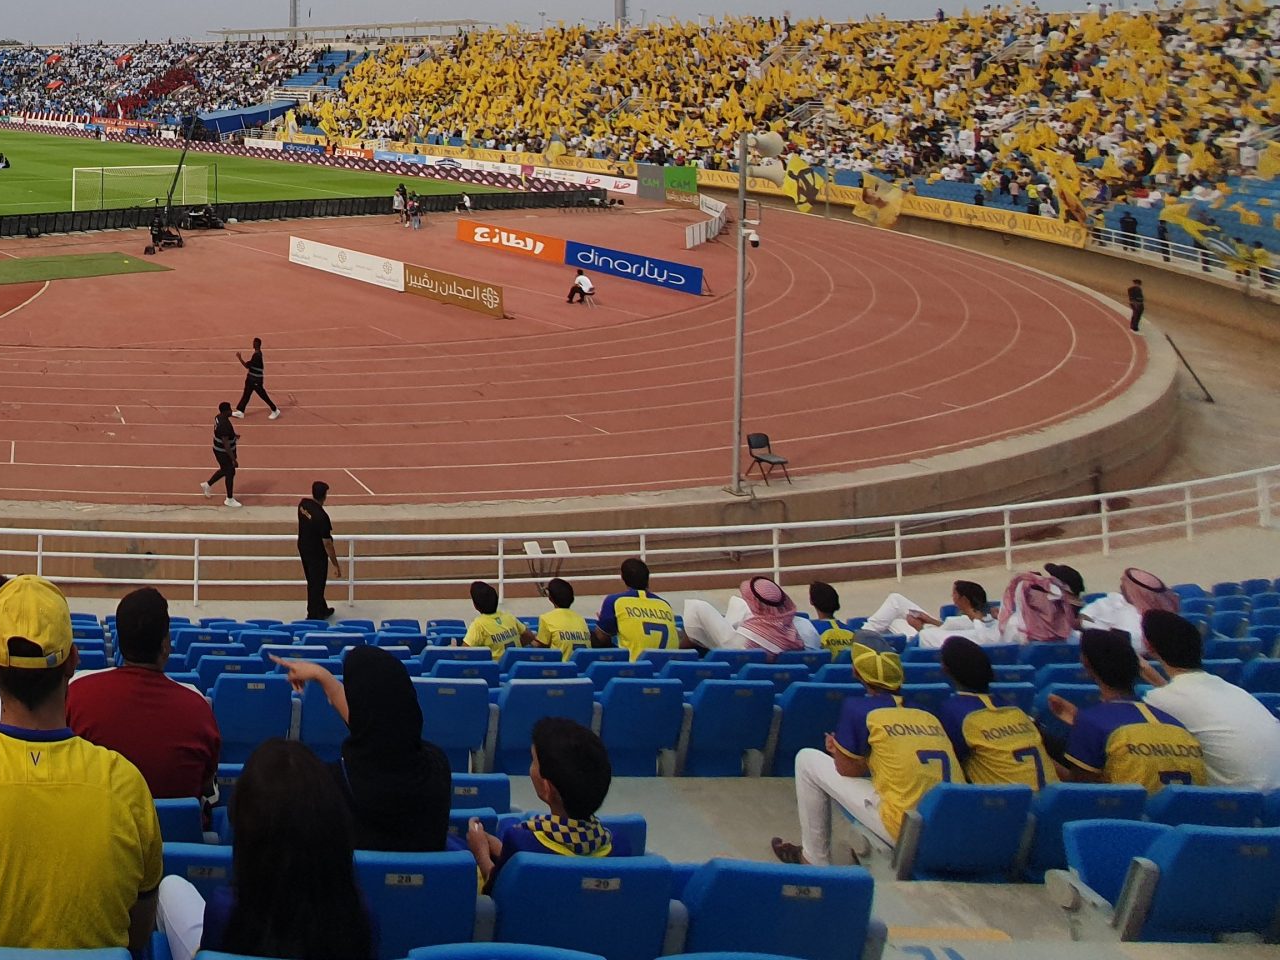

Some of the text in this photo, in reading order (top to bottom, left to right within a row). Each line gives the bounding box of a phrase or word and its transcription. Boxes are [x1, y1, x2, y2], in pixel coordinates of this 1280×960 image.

[474, 227, 544, 254] الطازج
[440, 280, 480, 301] العجلان
[626, 606, 672, 622] RONALDO
[642, 622, 669, 649] 7
[916, 749, 951, 783] 7
[1012, 746, 1046, 789] 7
[397, 875, 411, 884] 28
[595, 879, 609, 889] 29
